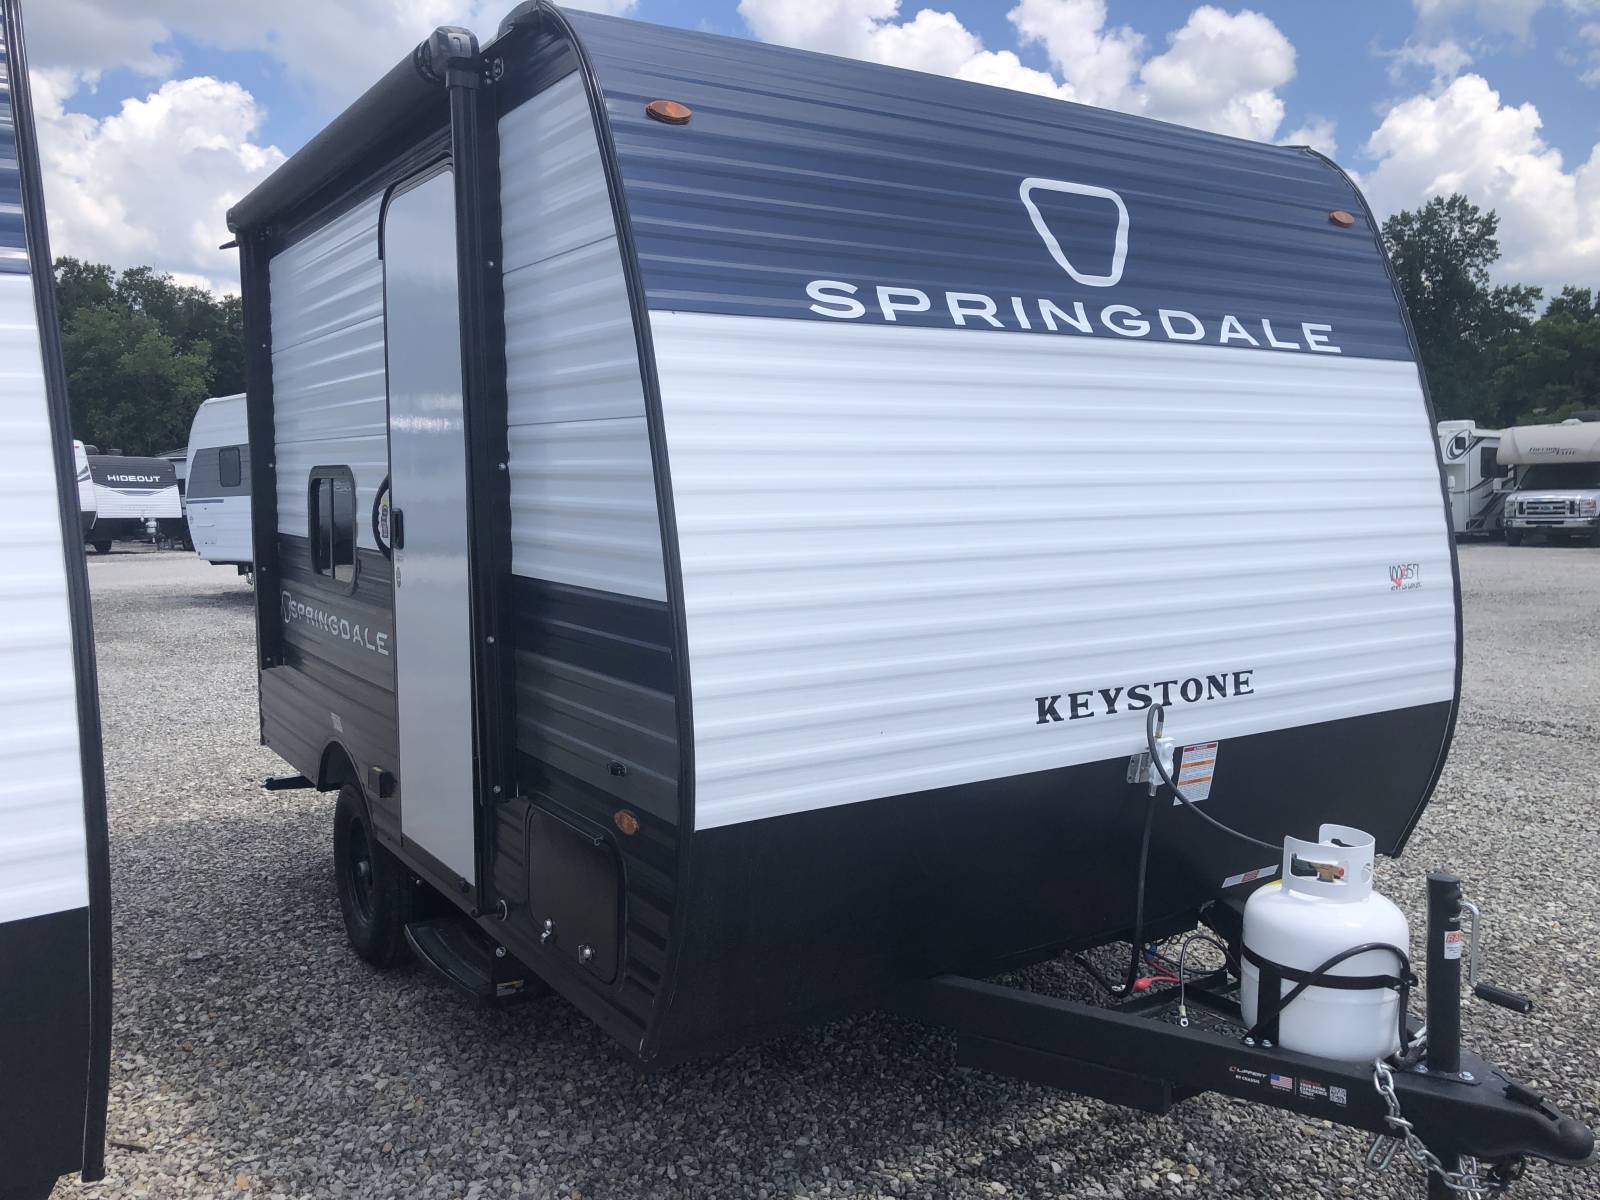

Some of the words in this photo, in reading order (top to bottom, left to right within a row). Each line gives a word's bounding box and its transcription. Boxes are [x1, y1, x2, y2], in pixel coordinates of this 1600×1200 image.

[805, 279, 1342, 354] SPRINGDALE
[106, 474, 161, 483] HIDEOUT
[290, 600, 389, 656] SPRINGDALE
[1034, 669, 1255, 725] KEYSTONE
